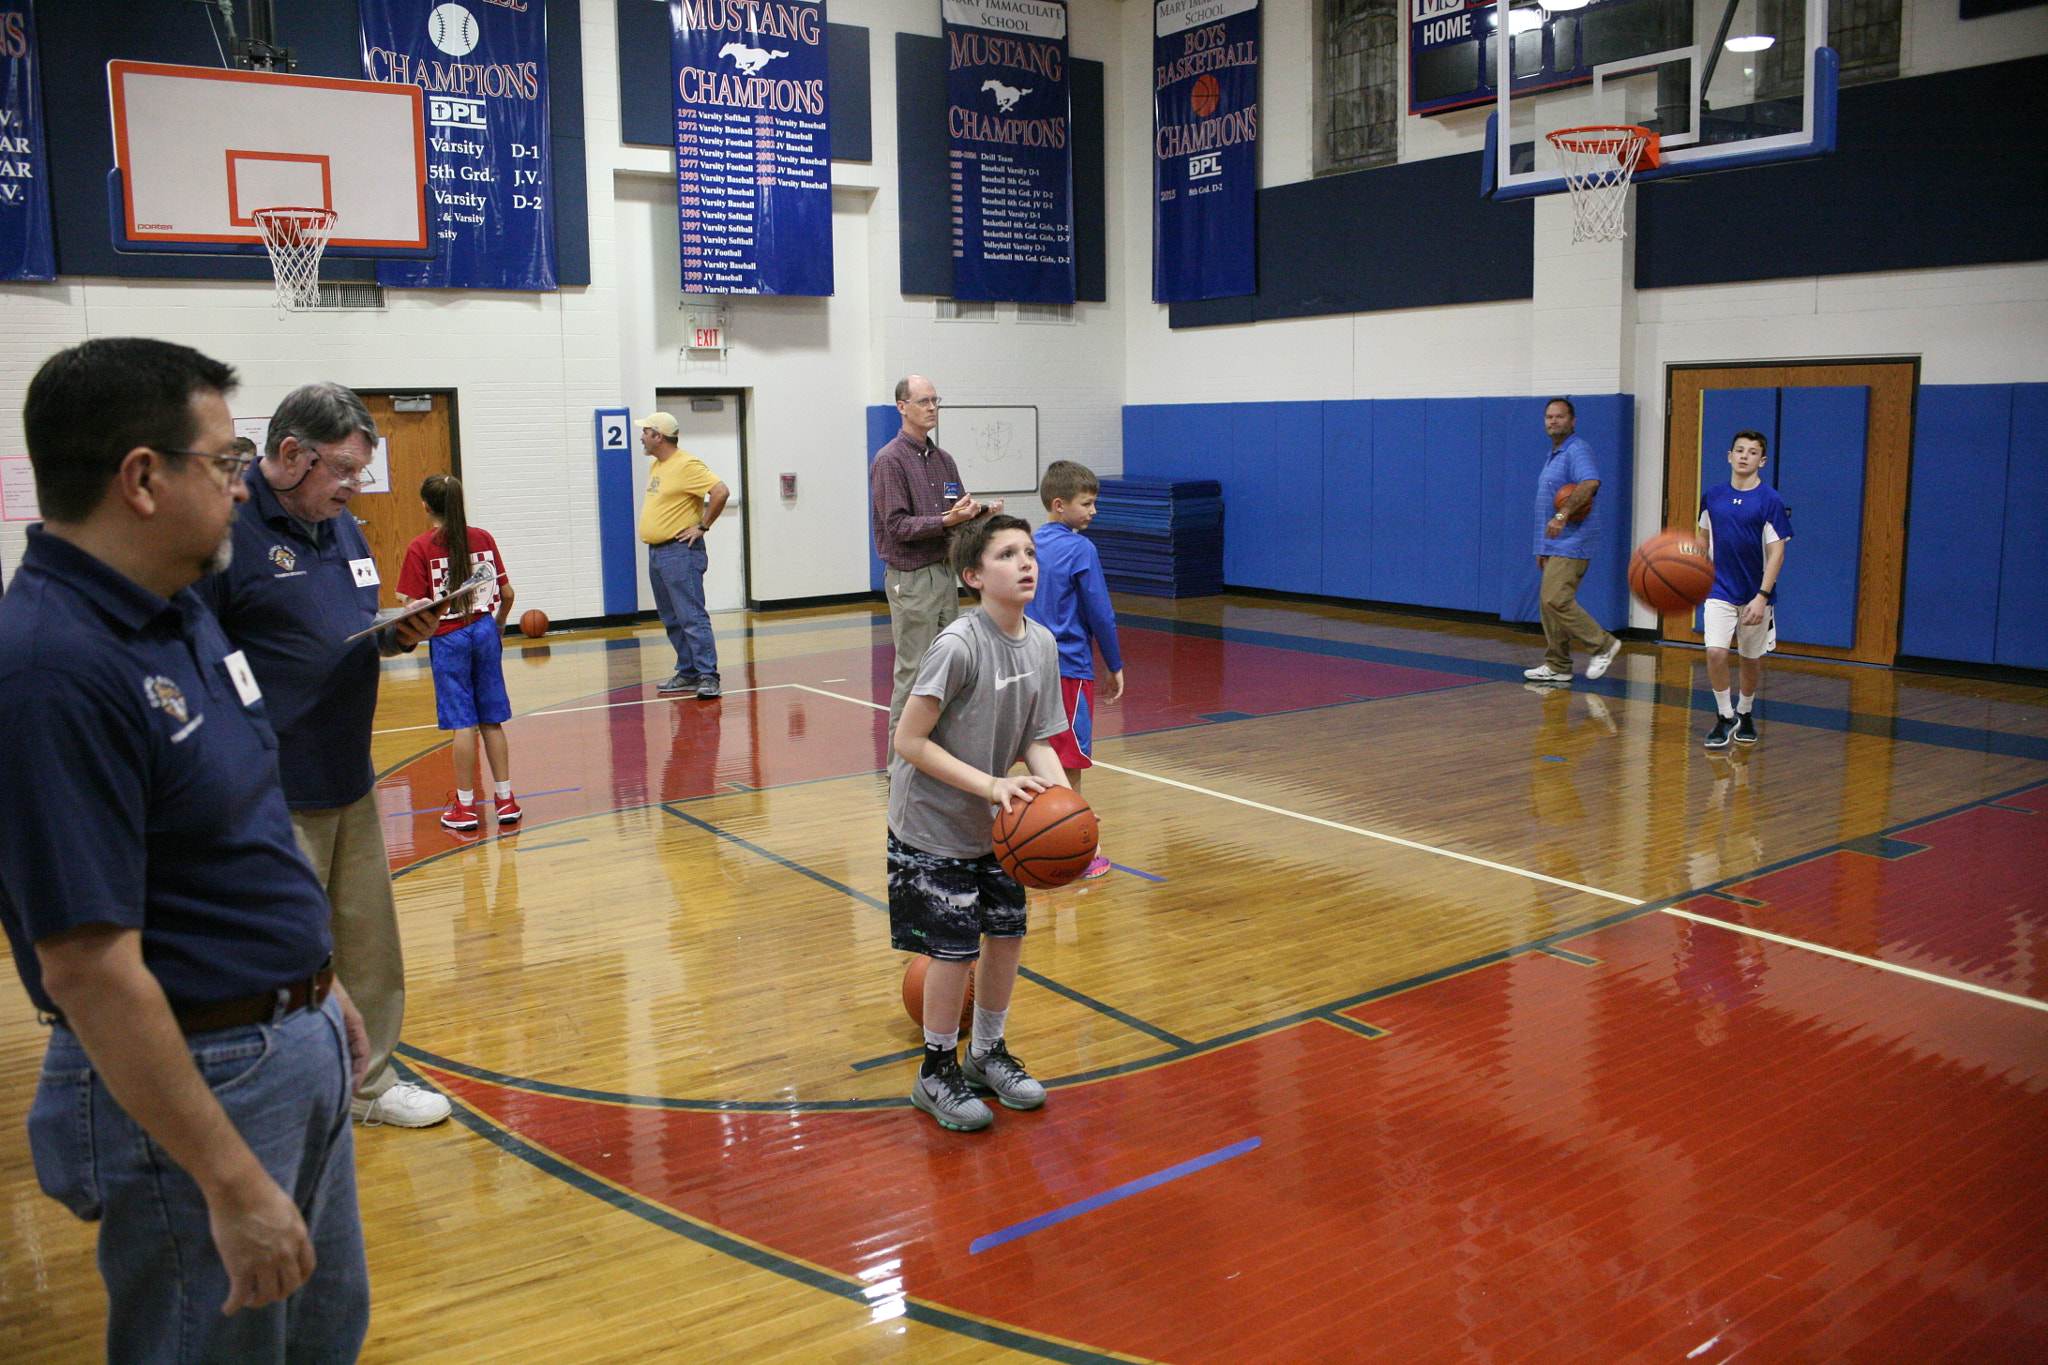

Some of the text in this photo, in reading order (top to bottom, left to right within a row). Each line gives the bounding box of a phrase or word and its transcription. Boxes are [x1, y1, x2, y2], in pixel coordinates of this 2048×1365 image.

[984, 0, 1062, 19] IMMACULATE
[1160, 0, 1187, 17] MARY
[1185, 4, 1225, 25] SCHOOL
[680, 0, 820, 45] MUSTANG
[981, 12, 1032, 32] SCHOOL
[1424, 13, 1471, 45] HOME
[1184, 23, 1226, 55] BOYS
[948, 31, 1062, 81] MUSTANG
[1157, 41, 1257, 90] BASKETBALL
[369, 47, 538, 100] CHAMPIONS
[680, 66, 824, 115] CHAMPIONS
[430, 101, 487, 124] DPL
[678, 108, 750, 122] 1972 Varsity Softball
[678, 121, 753, 135] 1972 Varsity Baseball
[775, 118, 798, 128] Varsity
[800, 121, 826, 130] Baseball
[948, 104, 1066, 149] CHAMPIONS
[786, 131, 812, 140] Baseball
[1156, 104, 1257, 160] CHAMPIONS
[699, 136, 724, 147] Varsity
[726, 138, 752, 147] Football
[429, 138, 539, 159] Varsity D-1
[679, 146, 753, 160] 1975 Varsity Football
[786, 144, 812, 152] Baseball
[680, 159, 753, 172] 1977 Varsity Football
[777, 154, 798, 165] Varsity
[800, 157, 826, 166] Baseball
[787, 168, 813, 176] Baseball
[982, 164, 1005, 172] Baseball
[1007, 166, 1027, 176] Varsity
[1189, 157, 1222, 176] DPL
[429, 164, 542, 187] 5th Grd. J.V.
[700, 174, 725, 184] Varsity
[727, 175, 754, 184] Baseball
[982, 175, 1005, 183] Baseball
[681, 184, 754, 196] 1994 Varsity Baseball
[778, 178, 799, 189] Varsity
[801, 181, 827, 190] Baseball
[982, 186, 1005, 194] Baseball
[434, 190, 542, 211] Varsity D-2
[701, 198, 726, 208] Varsity
[728, 200, 754, 208] Baseball
[982, 197, 1005, 205] Baseball
[442, 212, 485, 226] & Varsity
[702, 211, 727, 221] Varsity
[728, 212, 752, 221] Softball
[983, 208, 1005, 216] Baseball
[1008, 211, 1028, 219] Varsity
[682, 222, 753, 233] 1997 Varsity Softball
[983, 219, 1011, 227] Basketball
[983, 230, 1012, 238] Basketball
[703, 236, 727, 246] Varsity
[729, 237, 753, 245] Softball
[984, 241, 1011, 250] Volleyball
[1013, 243, 1033, 252] Varsity
[715, 248, 741, 257] Football
[984, 252, 1012, 260] Basketball
[704, 261, 728, 270] Varsity
[730, 262, 756, 270] Baseball
[704, 286, 729, 294] Varsity
[730, 286, 756, 294] Baseball
[697, 329, 719, 346] EXIT
[608, 426, 622, 446] 2
